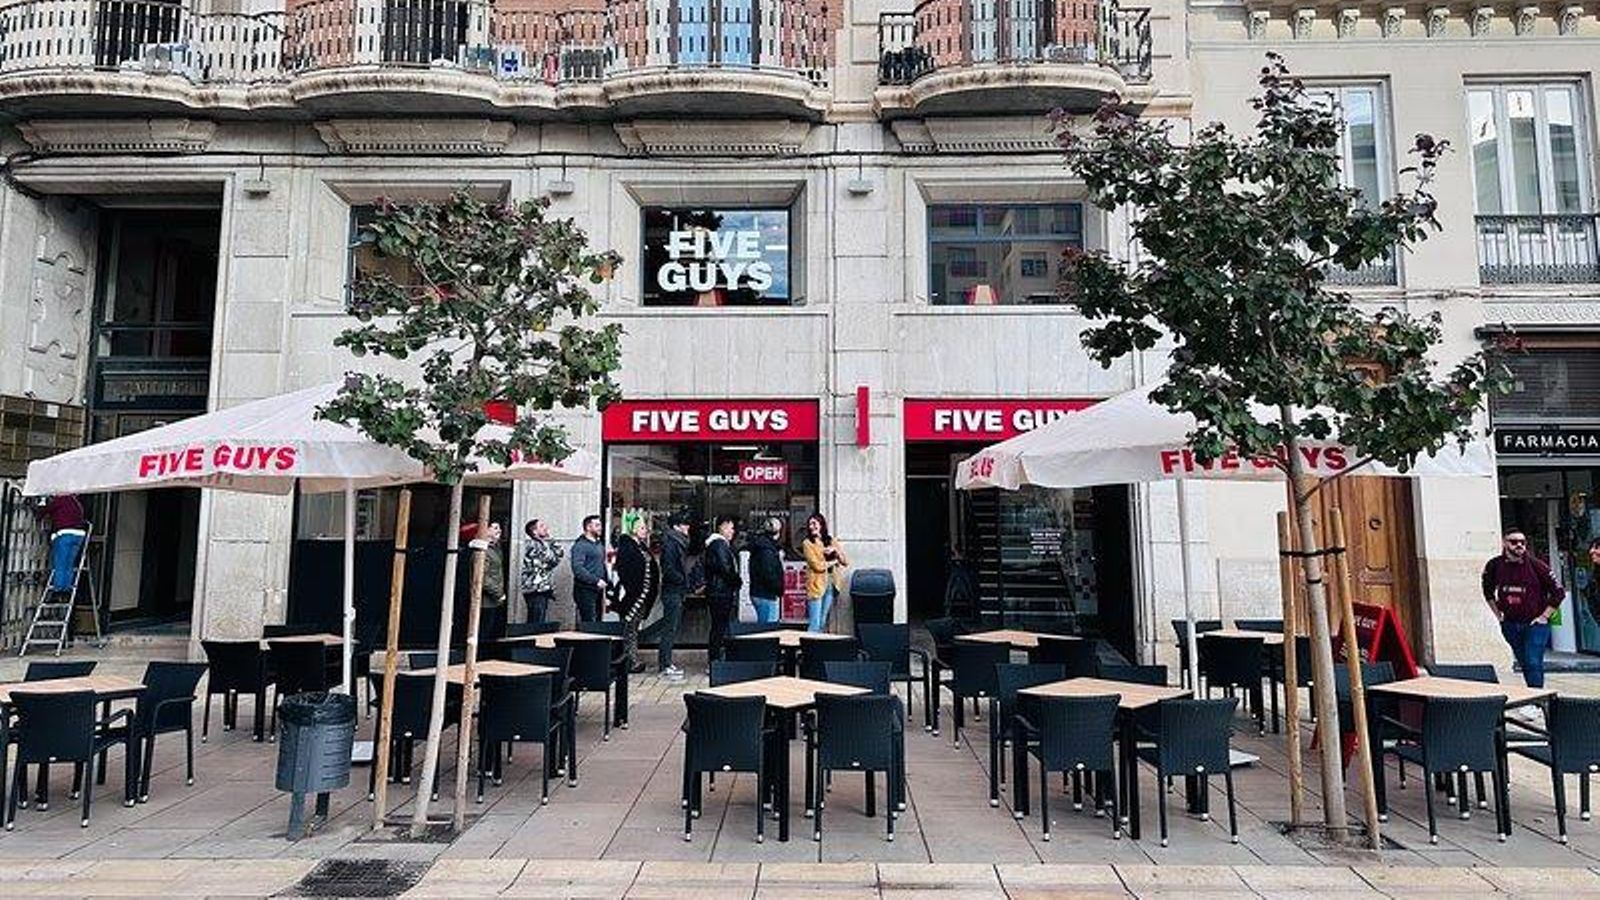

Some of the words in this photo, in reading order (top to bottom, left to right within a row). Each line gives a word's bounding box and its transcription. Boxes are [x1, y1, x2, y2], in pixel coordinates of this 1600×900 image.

[669, 231, 761, 259] FIVE
[657, 261, 772, 291] GUYS
[632, 410, 700, 432] FIVE
[709, 409, 789, 431] GUYS
[934, 409, 1004, 432] FIVE
[1012, 408, 1077, 431] GU
[1503, 434, 1599, 448] FARMACIA
[138, 448, 205, 477] FIVE
[213, 444, 297, 470] GUYS
[743, 465, 785, 481] OPEN
